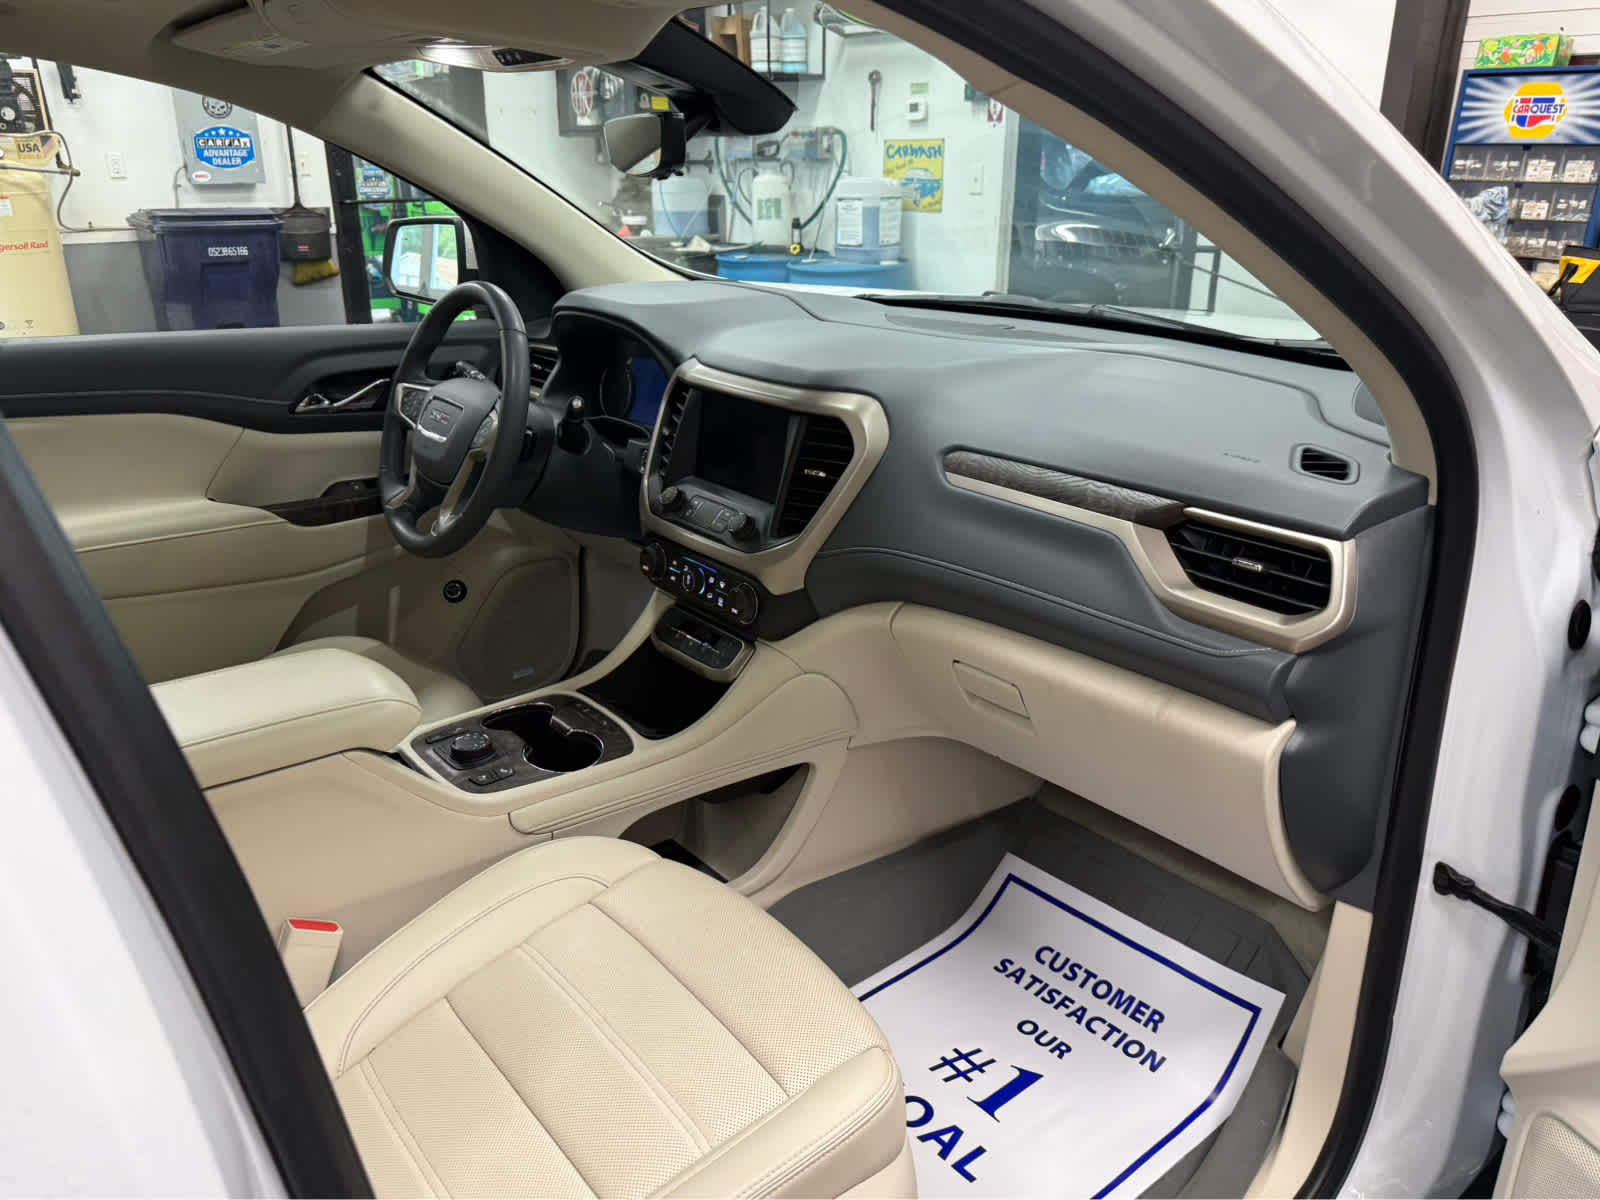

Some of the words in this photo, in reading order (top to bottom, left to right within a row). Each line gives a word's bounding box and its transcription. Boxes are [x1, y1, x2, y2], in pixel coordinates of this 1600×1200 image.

[1513, 103, 1565, 114] CARQUEST
[17, 143, 41, 153] USA
[197, 138, 250, 149] CARFAX
[203, 149, 248, 158] ADVANTAGE
[212, 157, 242, 166] DEALER
[1034, 945, 1165, 1034] CUSTOMER
[993, 958, 1167, 1073] SATISFACTION
[1016, 1019, 1073, 1060] OUR
[928, 1047, 1044, 1123] #1
[903, 1094, 987, 1183] OAL
